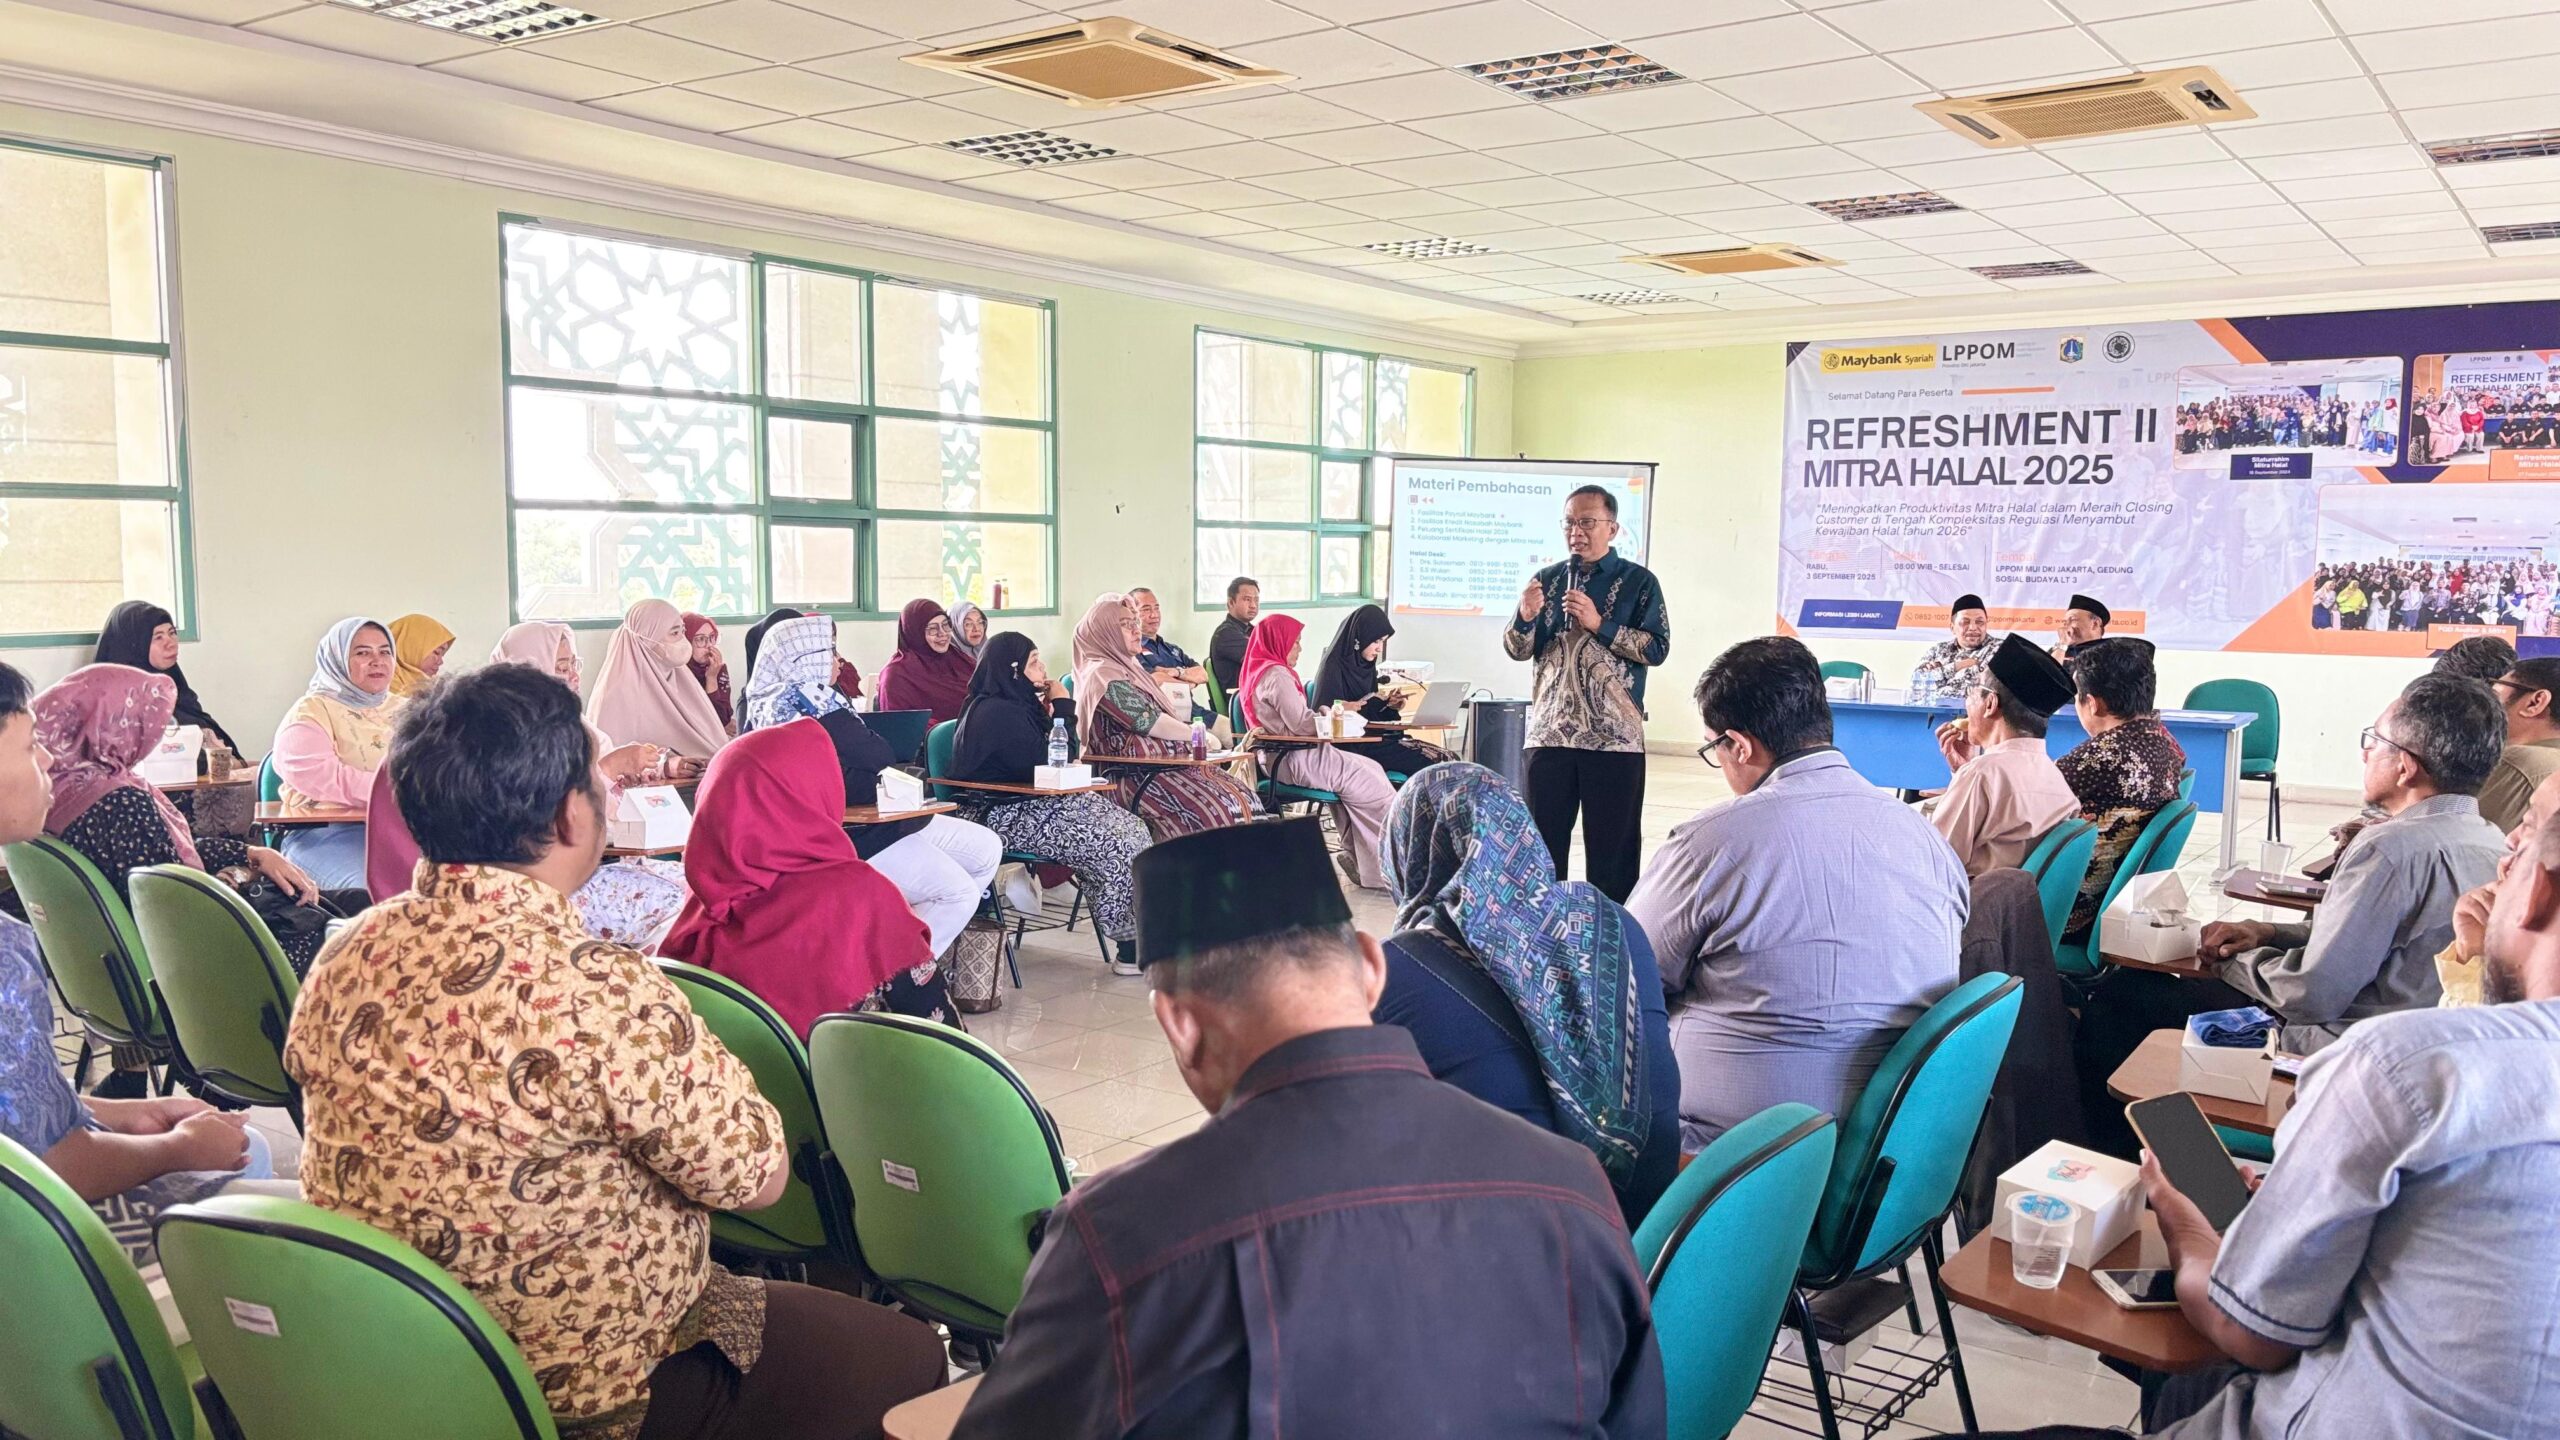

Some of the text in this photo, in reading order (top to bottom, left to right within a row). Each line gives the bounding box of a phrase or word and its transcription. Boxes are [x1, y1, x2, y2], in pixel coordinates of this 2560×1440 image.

[1942, 342, 2015, 361] LPPOM
[1840, 352, 1934, 369] Maybank Syariah
[2451, 372, 2544, 384] REFRESHMENT
[1828, 388, 1953, 401] Selamat Datang Para Peserta
[1806, 408, 2158, 451] REFRESHMENT II
[1803, 454, 2114, 488] MITRA HALAL 2025
[1408, 477, 1455, 491] Materi
[1457, 479, 1552, 496] Pembahasan
[1899, 502, 1972, 514] Produktivitas
[1975, 502, 2004, 513] Mitra
[2007, 502, 2037, 513] Halal
[2040, 502, 2076, 513] dalam
[2079, 502, 2122, 513] Meraih
[2125, 501, 2174, 515] Closing
[1815, 514, 2136, 527] Customer di Tengah Kompleksitas Regulasi Menyambut
[1815, 526, 1869, 538] Kewajiban
[1872, 526, 1900, 536] Halal
[1903, 526, 1934, 536] tahun
[1916, 563, 1933, 571] WIB
[1938, 563, 1970, 571] SELESAI
[1995, 565, 2024, 573] LPPOM
[2025, 565, 2041, 573] MUI
[2042, 565, 2056, 573] DKI
[2096, 566, 2134, 574] GEDUNG
[1857, 573, 1876, 581] 2025
[1995, 575, 2078, 584] SOSIAL BUDAYA LT 3
